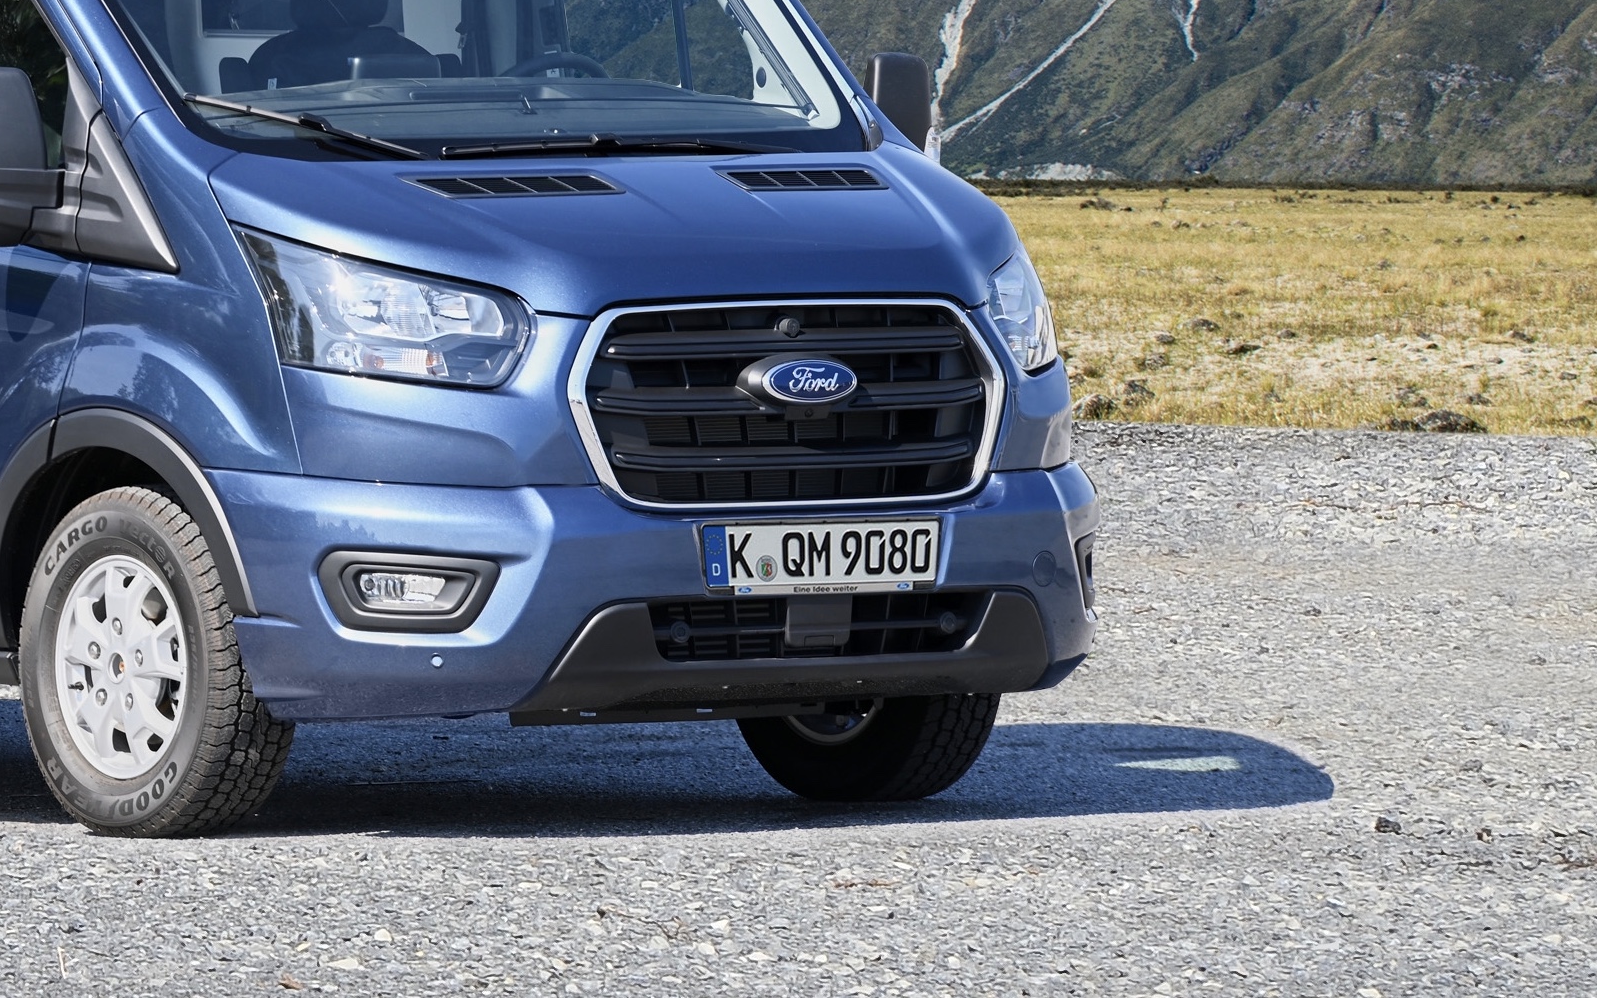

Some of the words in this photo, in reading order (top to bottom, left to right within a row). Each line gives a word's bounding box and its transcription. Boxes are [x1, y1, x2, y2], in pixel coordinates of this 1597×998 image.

[788, 366, 840, 393] Ford
[44, 515, 108, 576] CARGO
[728, 532, 755, 579] K
[781, 530, 832, 577] QM
[840, 528, 933, 576] 9080
[711, 563, 721, 577] D
[812, 585, 831, 593] Idee
